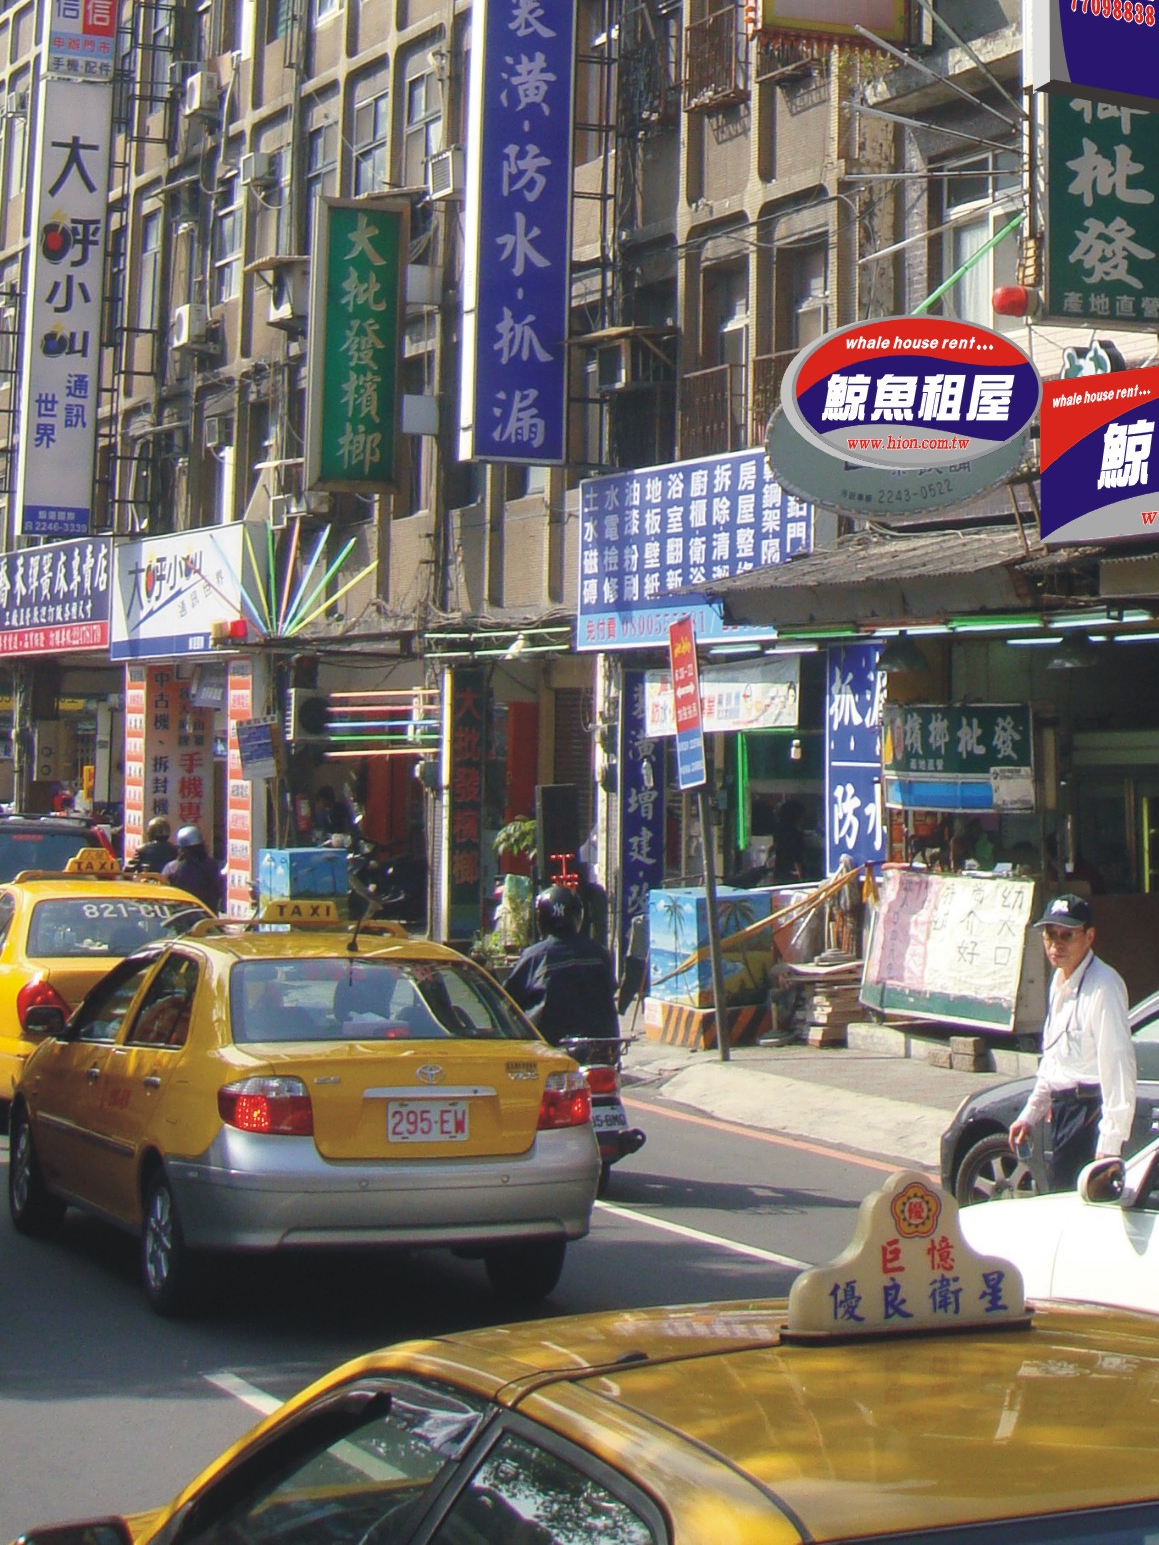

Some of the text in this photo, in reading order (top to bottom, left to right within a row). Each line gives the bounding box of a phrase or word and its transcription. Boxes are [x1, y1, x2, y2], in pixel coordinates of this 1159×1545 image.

[337, 213, 389, 476] 大批發檳榔
[846, 336, 890, 350] whale
[893, 336, 937, 350] house
[64, 373, 90, 429] 通訊
[821, 373, 1016, 422] 鯨魚租屋
[1052, 393, 1083, 409] whale
[1084, 390, 1115, 405] house
[34, 393, 59, 450] 世界
[847, 434, 971, 451] www.hion.com.tw
[877, 478, 954, 504] 2243-0522
[585, 617, 617, 641] 免付費
[904, 712, 1022, 760] 檳榔批發
[75, 861, 115, 871] TAXI
[276, 905, 331, 917] TAXI
[391, 1109, 466, 1136] 295-EW
[829, 1270, 1008, 1322] 優良衛星
